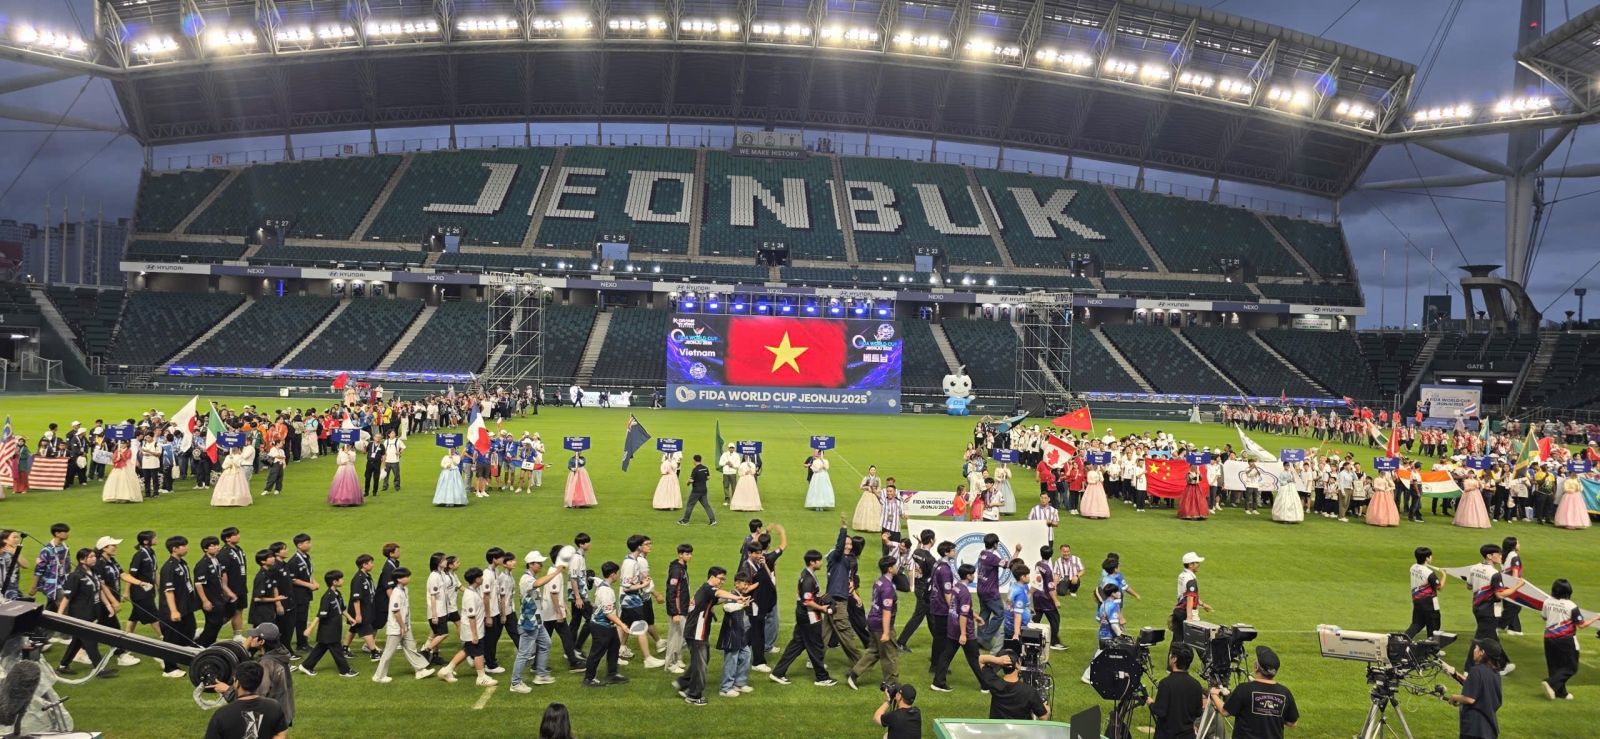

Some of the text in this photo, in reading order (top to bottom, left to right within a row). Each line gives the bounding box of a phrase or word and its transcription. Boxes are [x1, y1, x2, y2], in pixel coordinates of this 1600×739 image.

[422, 162, 1106, 241] JEONBUK
[679, 348, 716, 357] Vietnam
[863, 353, 888, 363] 베트남
[699, 390, 867, 404] FIDA WORLD CUP JEONJU 2025
